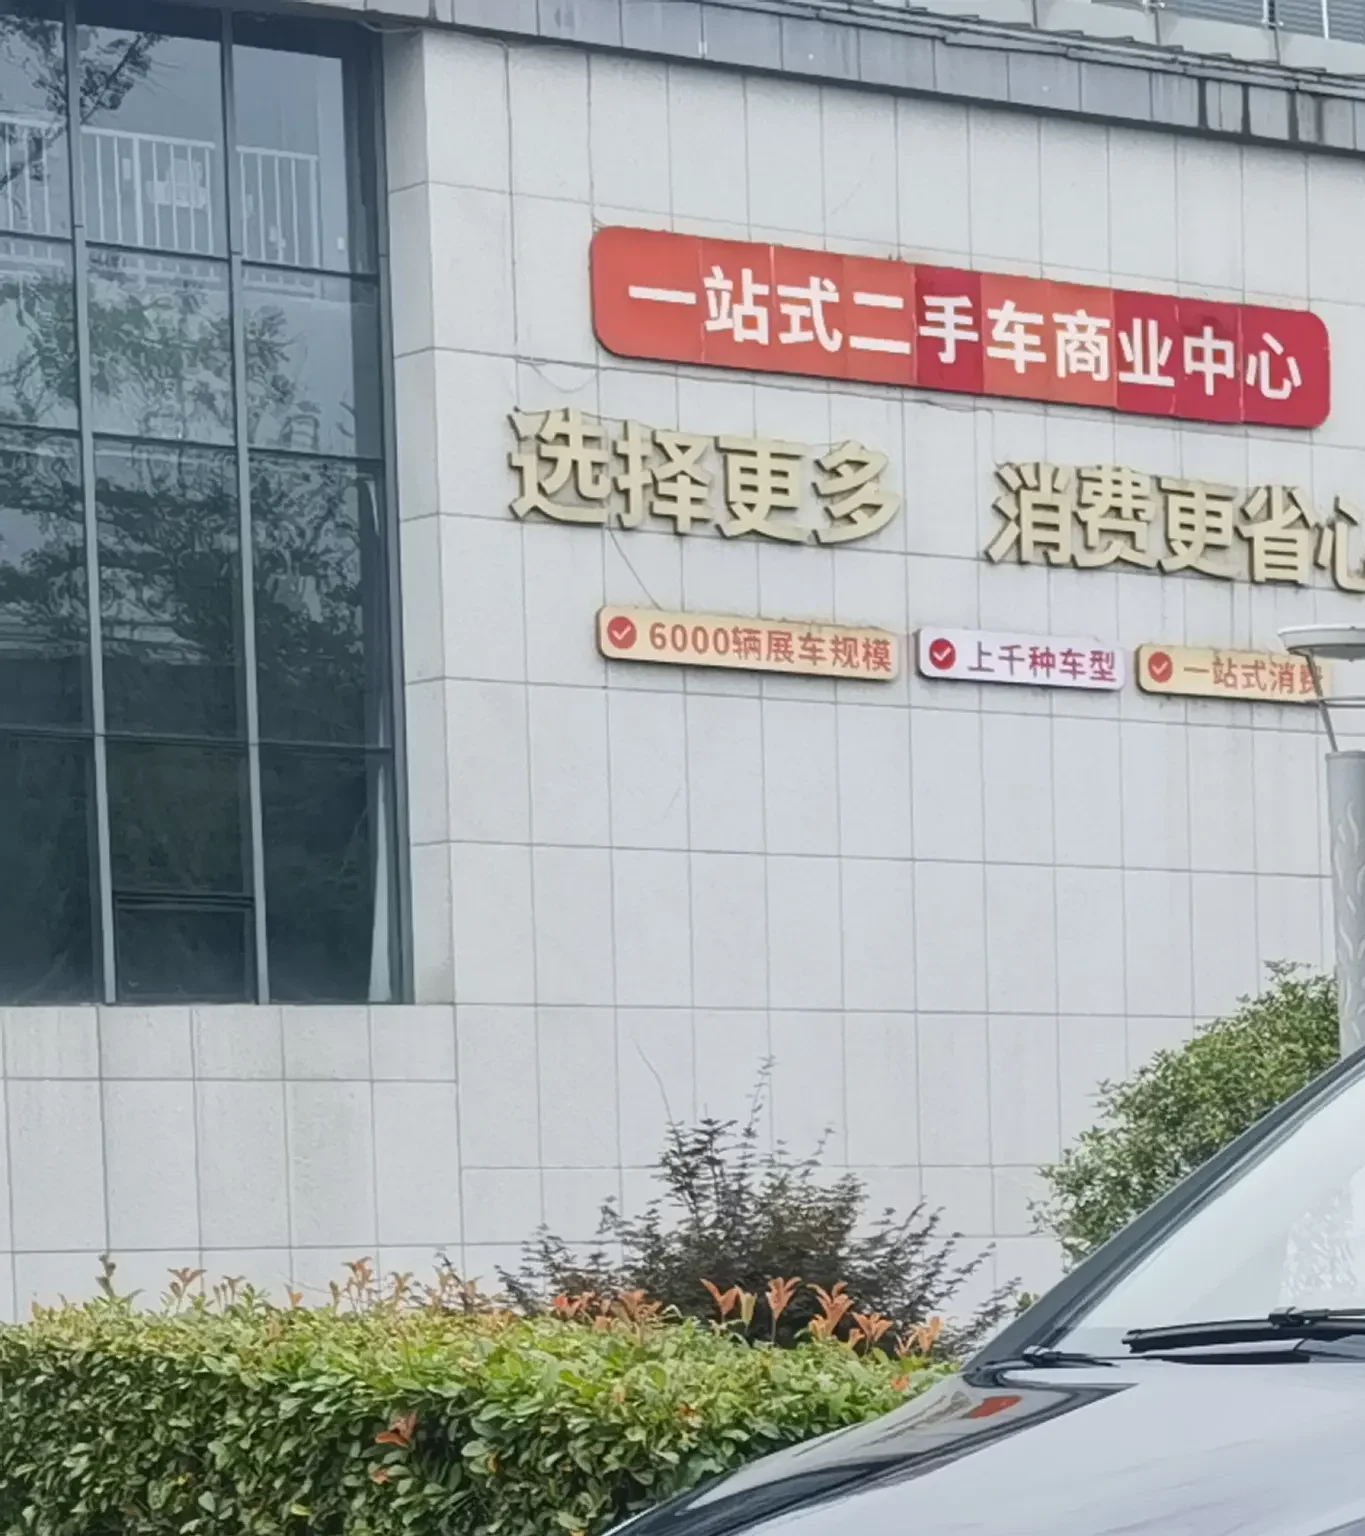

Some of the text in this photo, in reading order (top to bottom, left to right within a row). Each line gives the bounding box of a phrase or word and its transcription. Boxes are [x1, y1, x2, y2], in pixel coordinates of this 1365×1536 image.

[627, 265, 1303, 400] 一站式二手车商业中心
[507, 406, 902, 547] 选择更多
[649, 621, 893, 673] 6000辆展车规模
[967, 640, 1117, 682] 上千种车型
